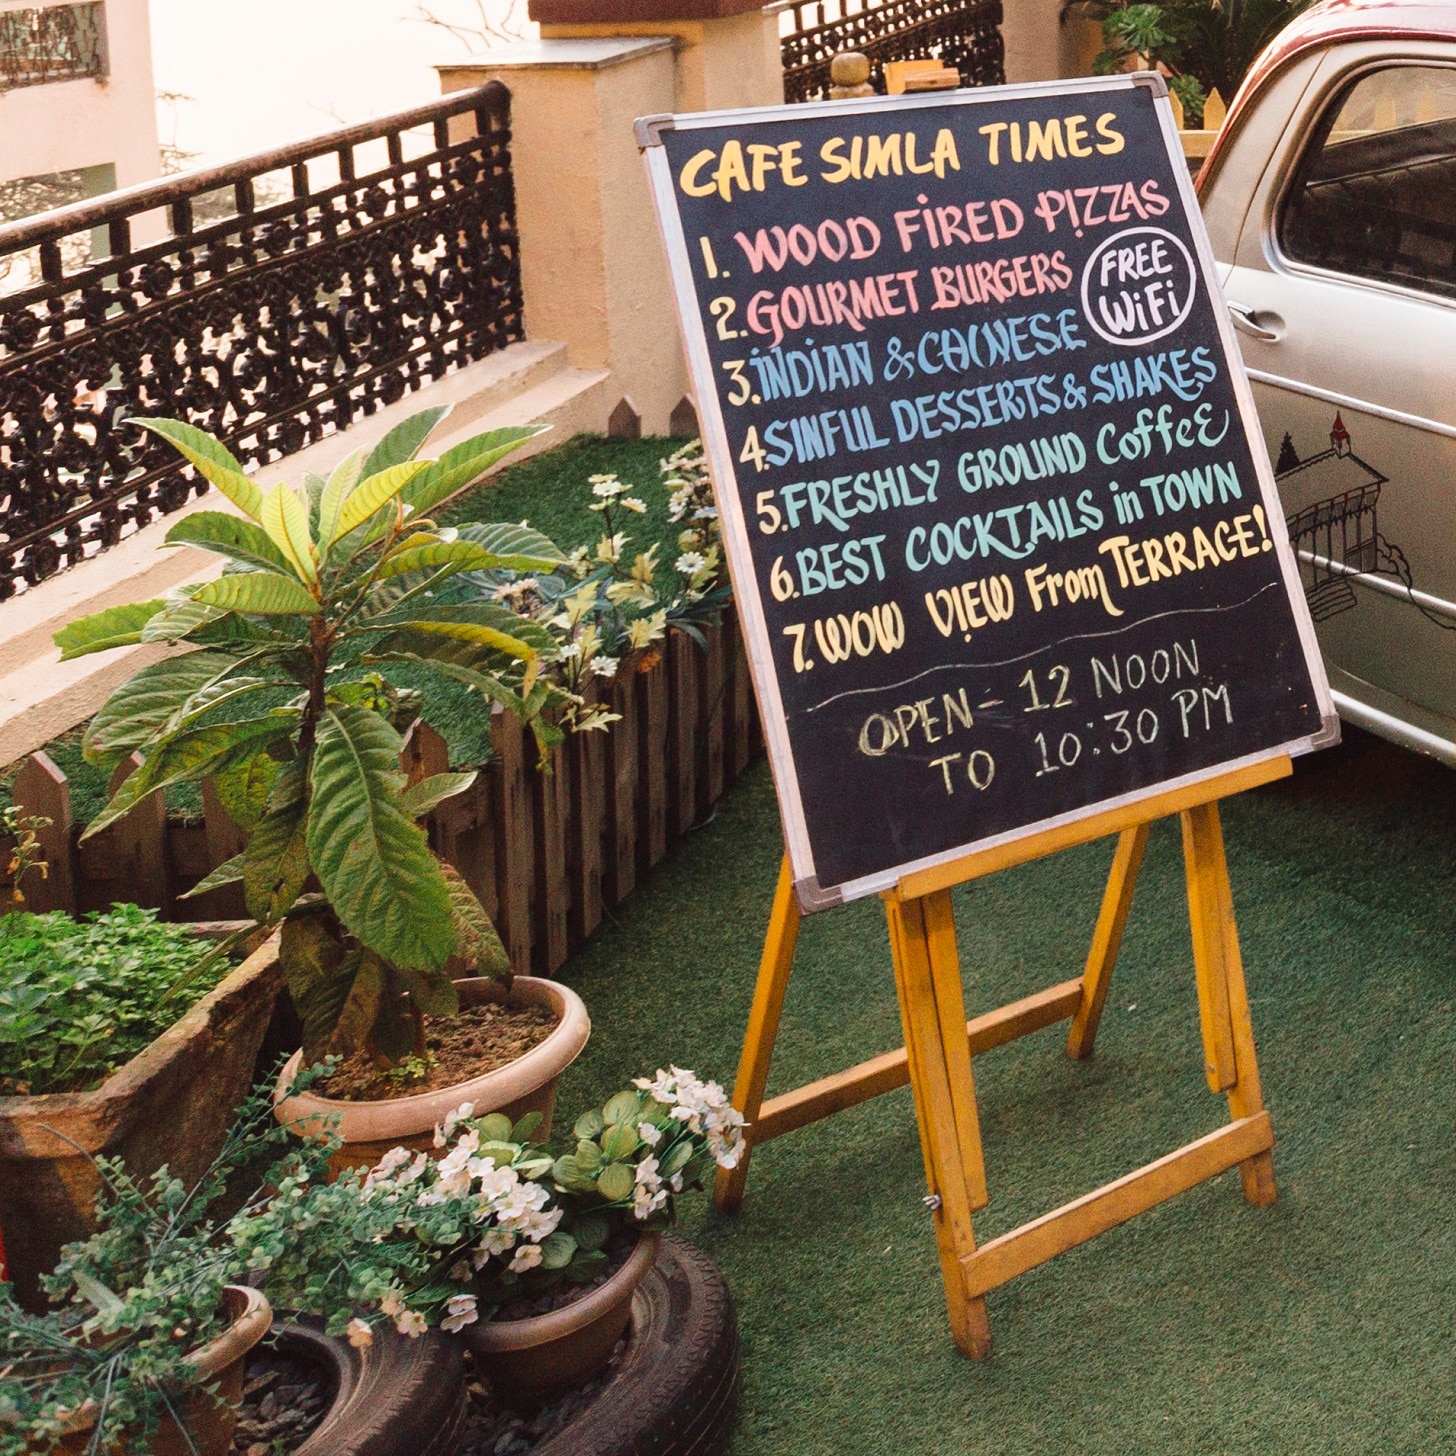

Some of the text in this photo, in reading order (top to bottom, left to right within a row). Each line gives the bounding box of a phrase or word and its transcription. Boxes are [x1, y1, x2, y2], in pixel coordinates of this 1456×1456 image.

[679, 112, 1125, 203] CAFE SIMLA TIMES
[734, 216, 881, 273] WOOD
[1034, 179, 1170, 238] PIZZAS
[1101, 239, 1173, 287] FREE
[746, 270, 918, 349] GOURMET
[931, 250, 1073, 311] BURGERS
[1099, 280, 1181, 335] WiFi
[763, 405, 891, 467] SINFUL
[1090, 346, 1217, 405] SHAKES
[780, 459, 940, 532] FRESHLY
[957, 431, 1086, 494] GROUND
[795, 534, 886, 597] BEST
[905, 489, 1104, 572] COCKTAILS
[1109, 481, 1144, 525] in
[1140, 461, 1242, 516] TOWN
[813, 600, 905, 665] WOW
[924, 573, 1014, 643] VIEW
[1024, 562, 1125, 617] From
[1098, 504, 1273, 588] TERRACE!
[1019, 665, 1074, 713] 12
[1091, 638, 1201, 698] NOON
[928, 684, 1234, 795] TO 10:30 PM
